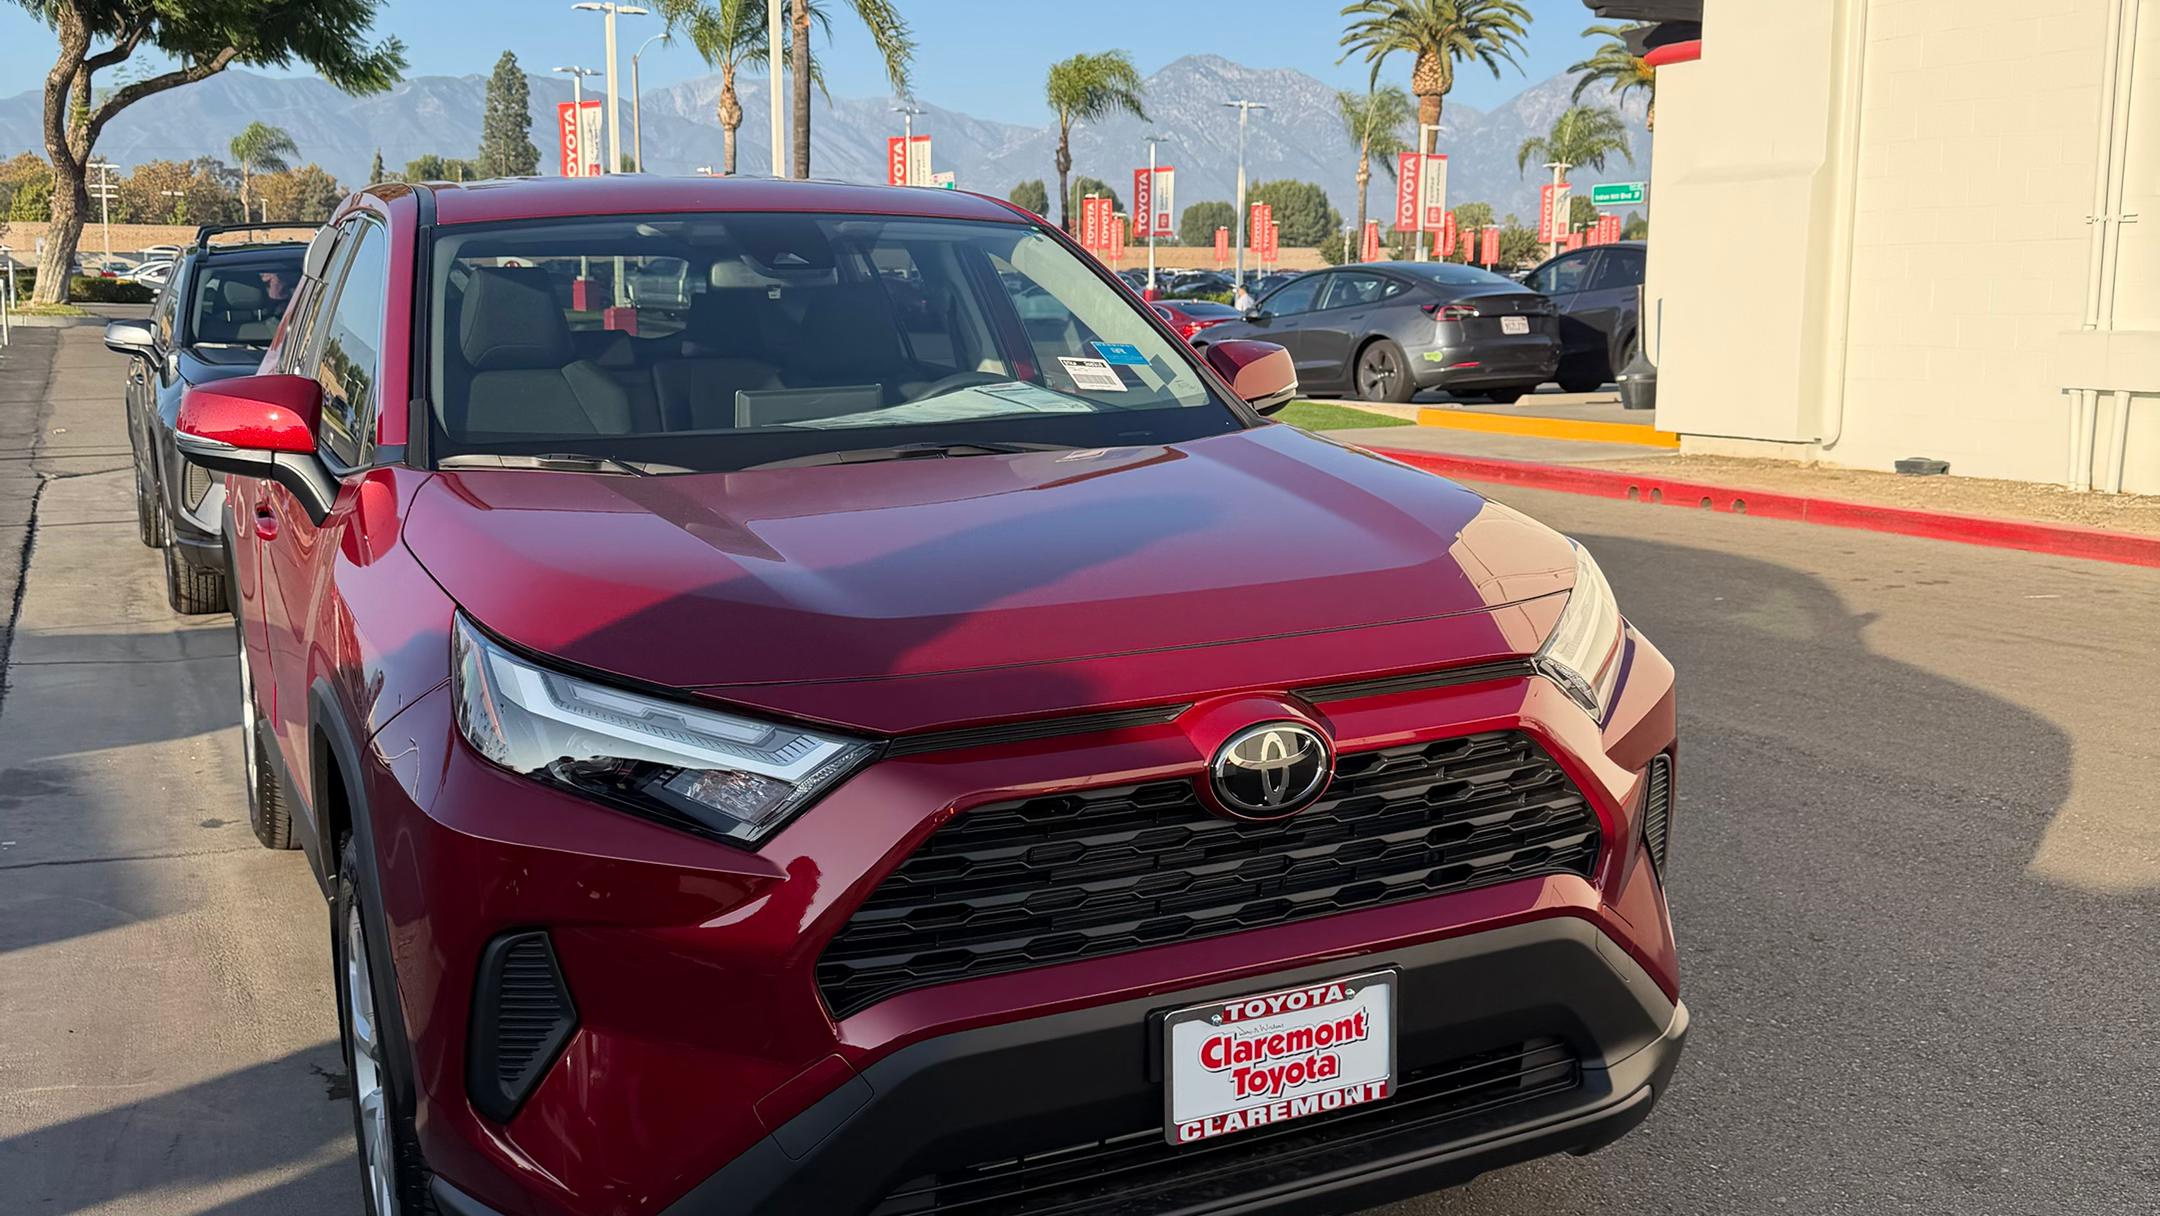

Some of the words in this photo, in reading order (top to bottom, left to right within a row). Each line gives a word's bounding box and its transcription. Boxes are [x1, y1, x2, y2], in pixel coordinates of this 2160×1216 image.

[564, 108, 577, 178] OYOTA
[893, 141, 905, 186] YOTA
[1138, 172, 1149, 233] TOYOTA
[1401, 157, 1416, 227] TOYOTA
[1542, 188, 1552, 240] TOYOTA
[1086, 203, 1095, 246] TOYOTA
[1101, 202, 1110, 245] TOYOTA
[1224, 984, 1344, 1021] TOYOTA
[1200, 1010, 1367, 1069] Claremont
[1232, 1052, 1337, 1098] Toyota
[1179, 1080, 1387, 1142] CLAREMONT
